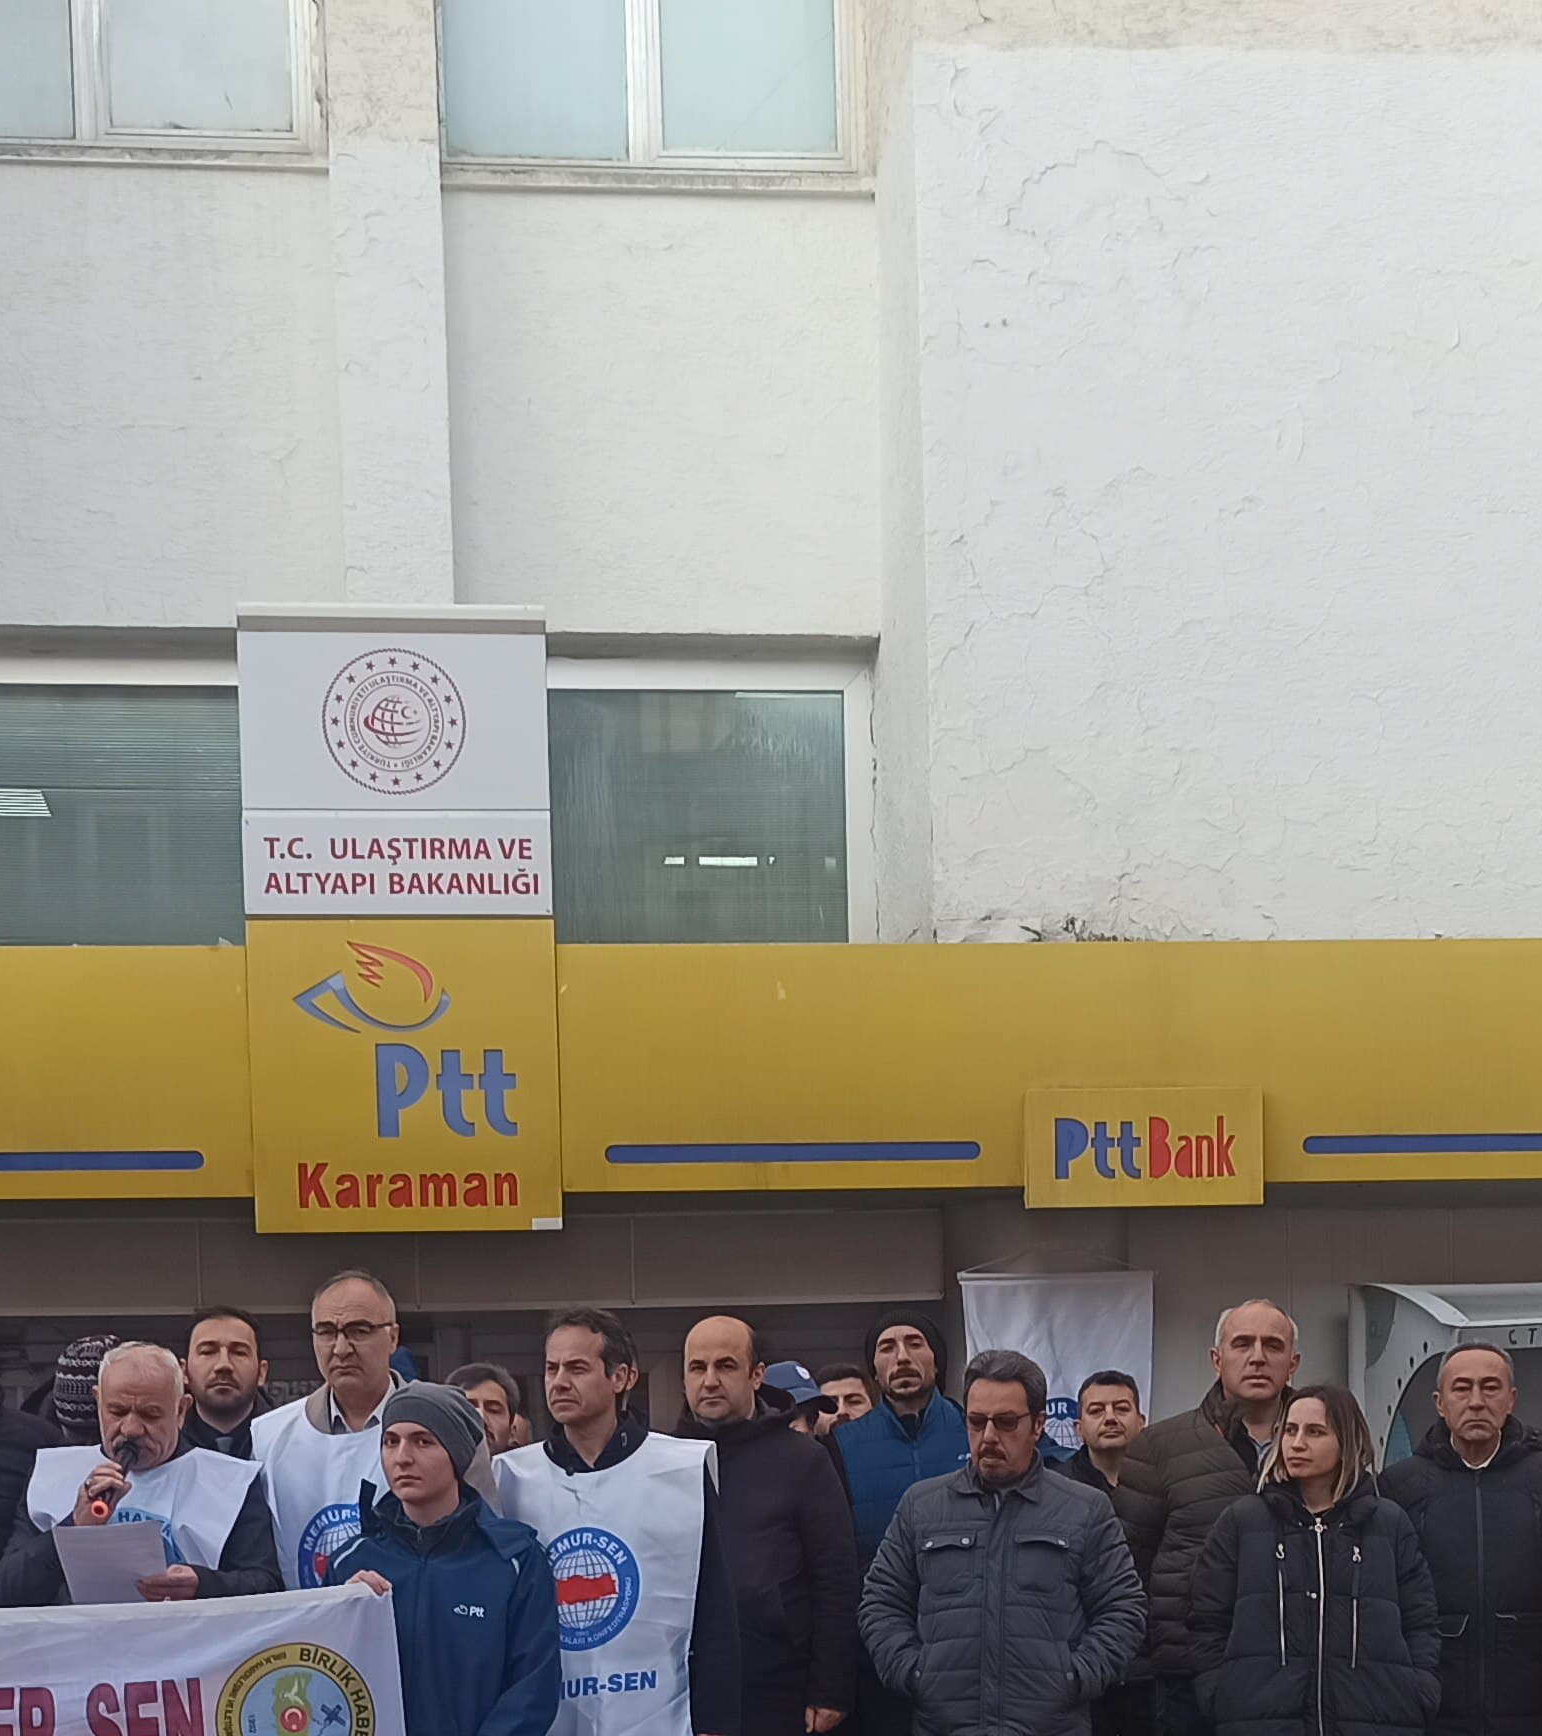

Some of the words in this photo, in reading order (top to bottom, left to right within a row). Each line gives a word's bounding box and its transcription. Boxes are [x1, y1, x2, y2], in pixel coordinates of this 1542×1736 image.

[263, 836, 313, 860] T.C.
[329, 837, 492, 866] ULAŞTIRMA
[497, 838, 533, 860] VE
[264, 872, 376, 895] ALTYAPI
[388, 868, 540, 895] BAKANLIĞI
[374, 1042, 519, 1138] Ptt
[296, 1161, 520, 1210] Karaman
[548, 1532, 628, 1566] EMUR-SEN
[469, 1604, 485, 1618] Ptt
[299, 1647, 357, 1689] BİRLİK
